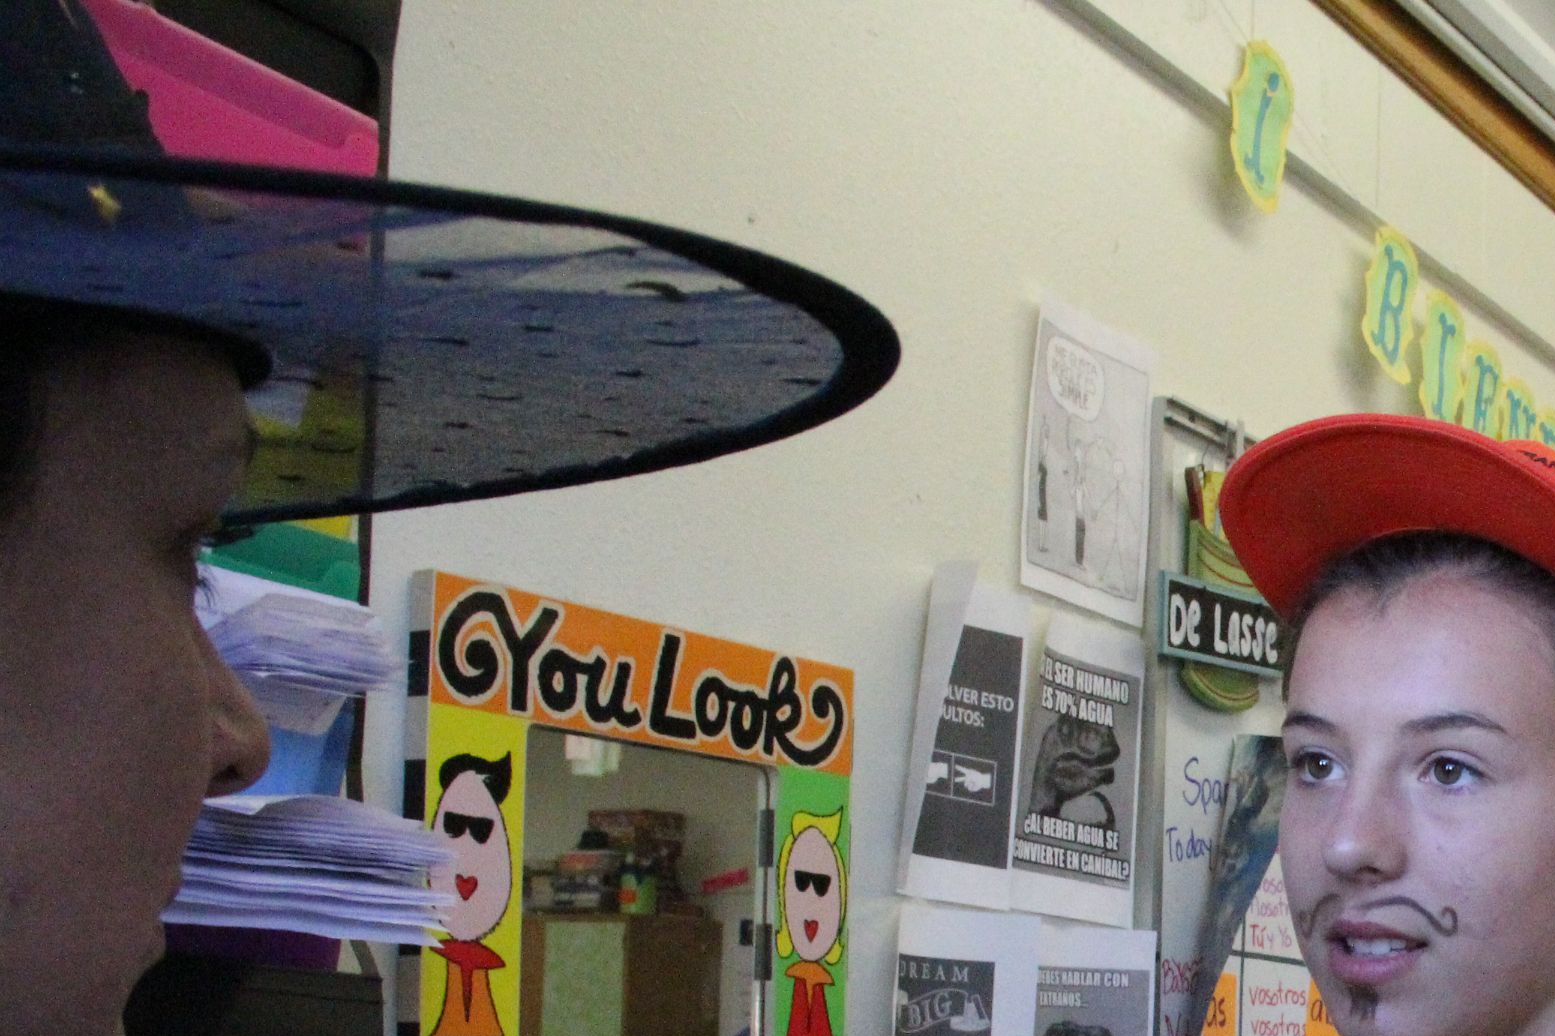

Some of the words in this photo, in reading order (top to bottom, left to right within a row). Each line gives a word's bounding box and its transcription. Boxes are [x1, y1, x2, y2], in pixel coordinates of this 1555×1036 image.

[1168, 593, 1200, 648] De
[438, 590, 641, 728] You
[649, 634, 845, 767] Look
[1054, 661, 1075, 689] SER
[1076, 669, 1129, 705] HUMANO
[980, 691, 1015, 713] ESTO
[1041, 684, 1054, 710] ES
[1055, 688, 1077, 718] 70%
[1078, 697, 1113, 728] AGUA
[1042, 815, 1075, 841] BEBER
[1076, 823, 1104, 848] AGUA
[1105, 829, 1119, 850] SE
[1166, 827, 1216, 871] Today
[1066, 849, 1080, 871] EN
[899, 960, 970, 982] DREAM
[1061, 970, 1101, 986] HABLAR
[1103, 972, 1129, 988] CON
[907, 992, 953, 1027] BIG
[1249, 984, 1306, 1006] vosotros
